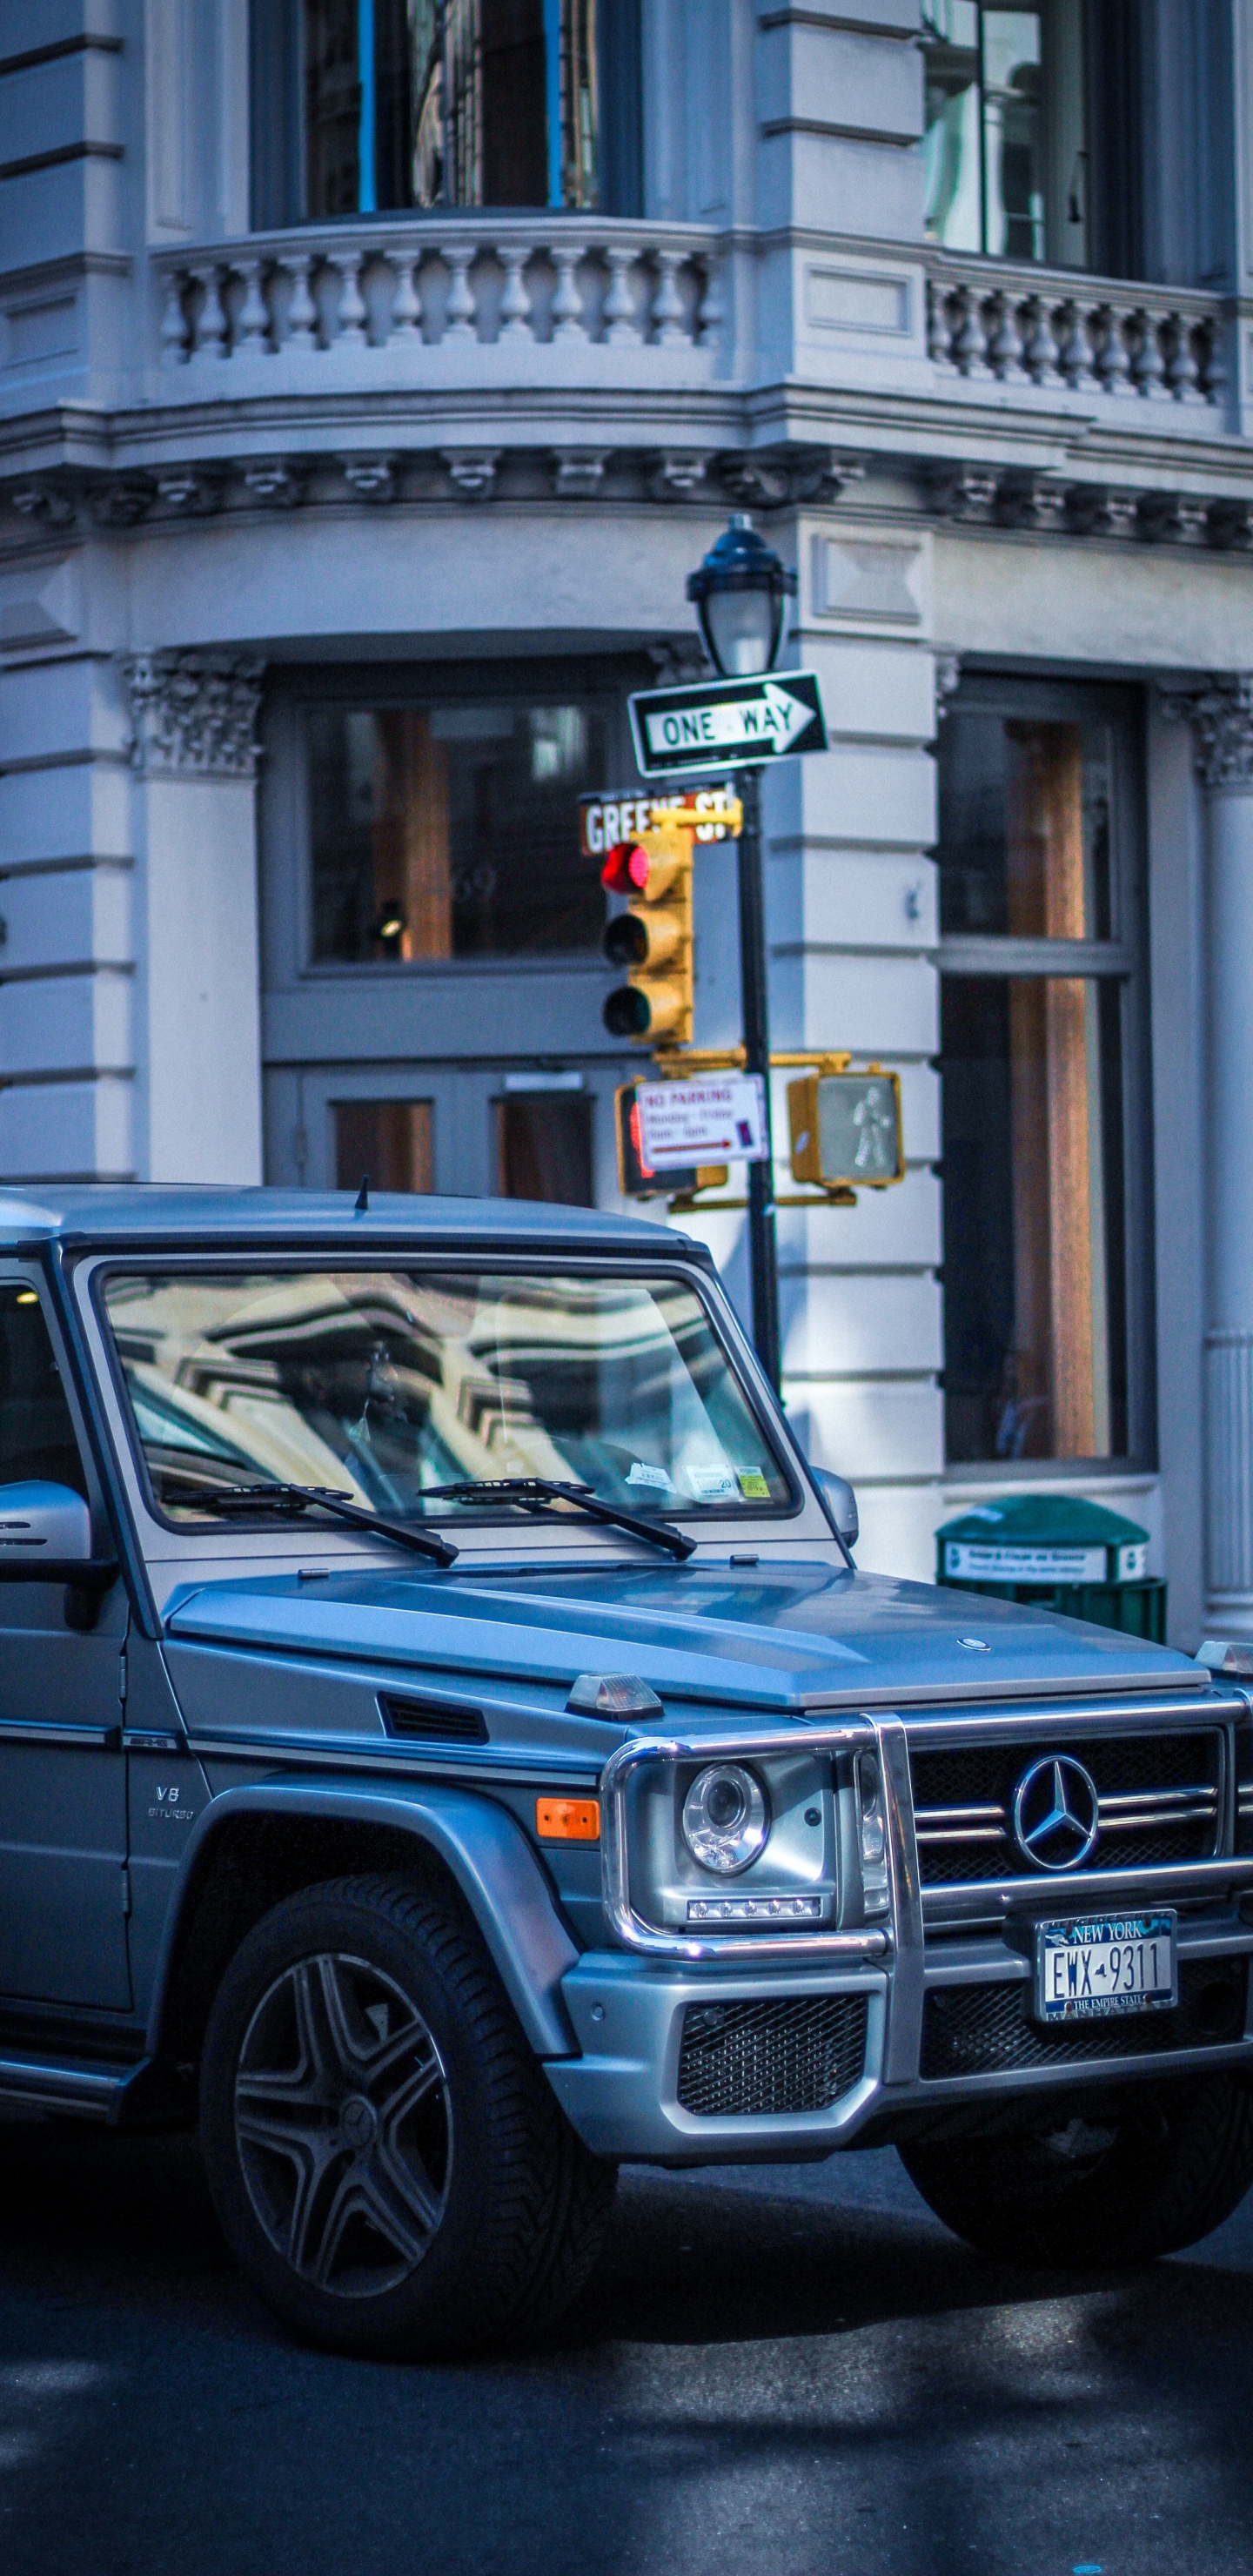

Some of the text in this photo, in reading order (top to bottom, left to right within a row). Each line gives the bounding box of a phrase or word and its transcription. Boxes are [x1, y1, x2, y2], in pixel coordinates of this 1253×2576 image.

[663, 702, 794, 747] ONE WAY
[646, 1088, 733, 1108] NO PARKING
[720, 1479, 732, 1489] 20
[157, 1786, 179, 1802] V8
[148, 1808, 194, 1820] BITURBO
[1073, 1920, 1142, 1944] NEW YORK
[1053, 1942, 1158, 1999] EWX 9311
[1073, 1994, 1142, 2011] THE EMPIRE STATE
